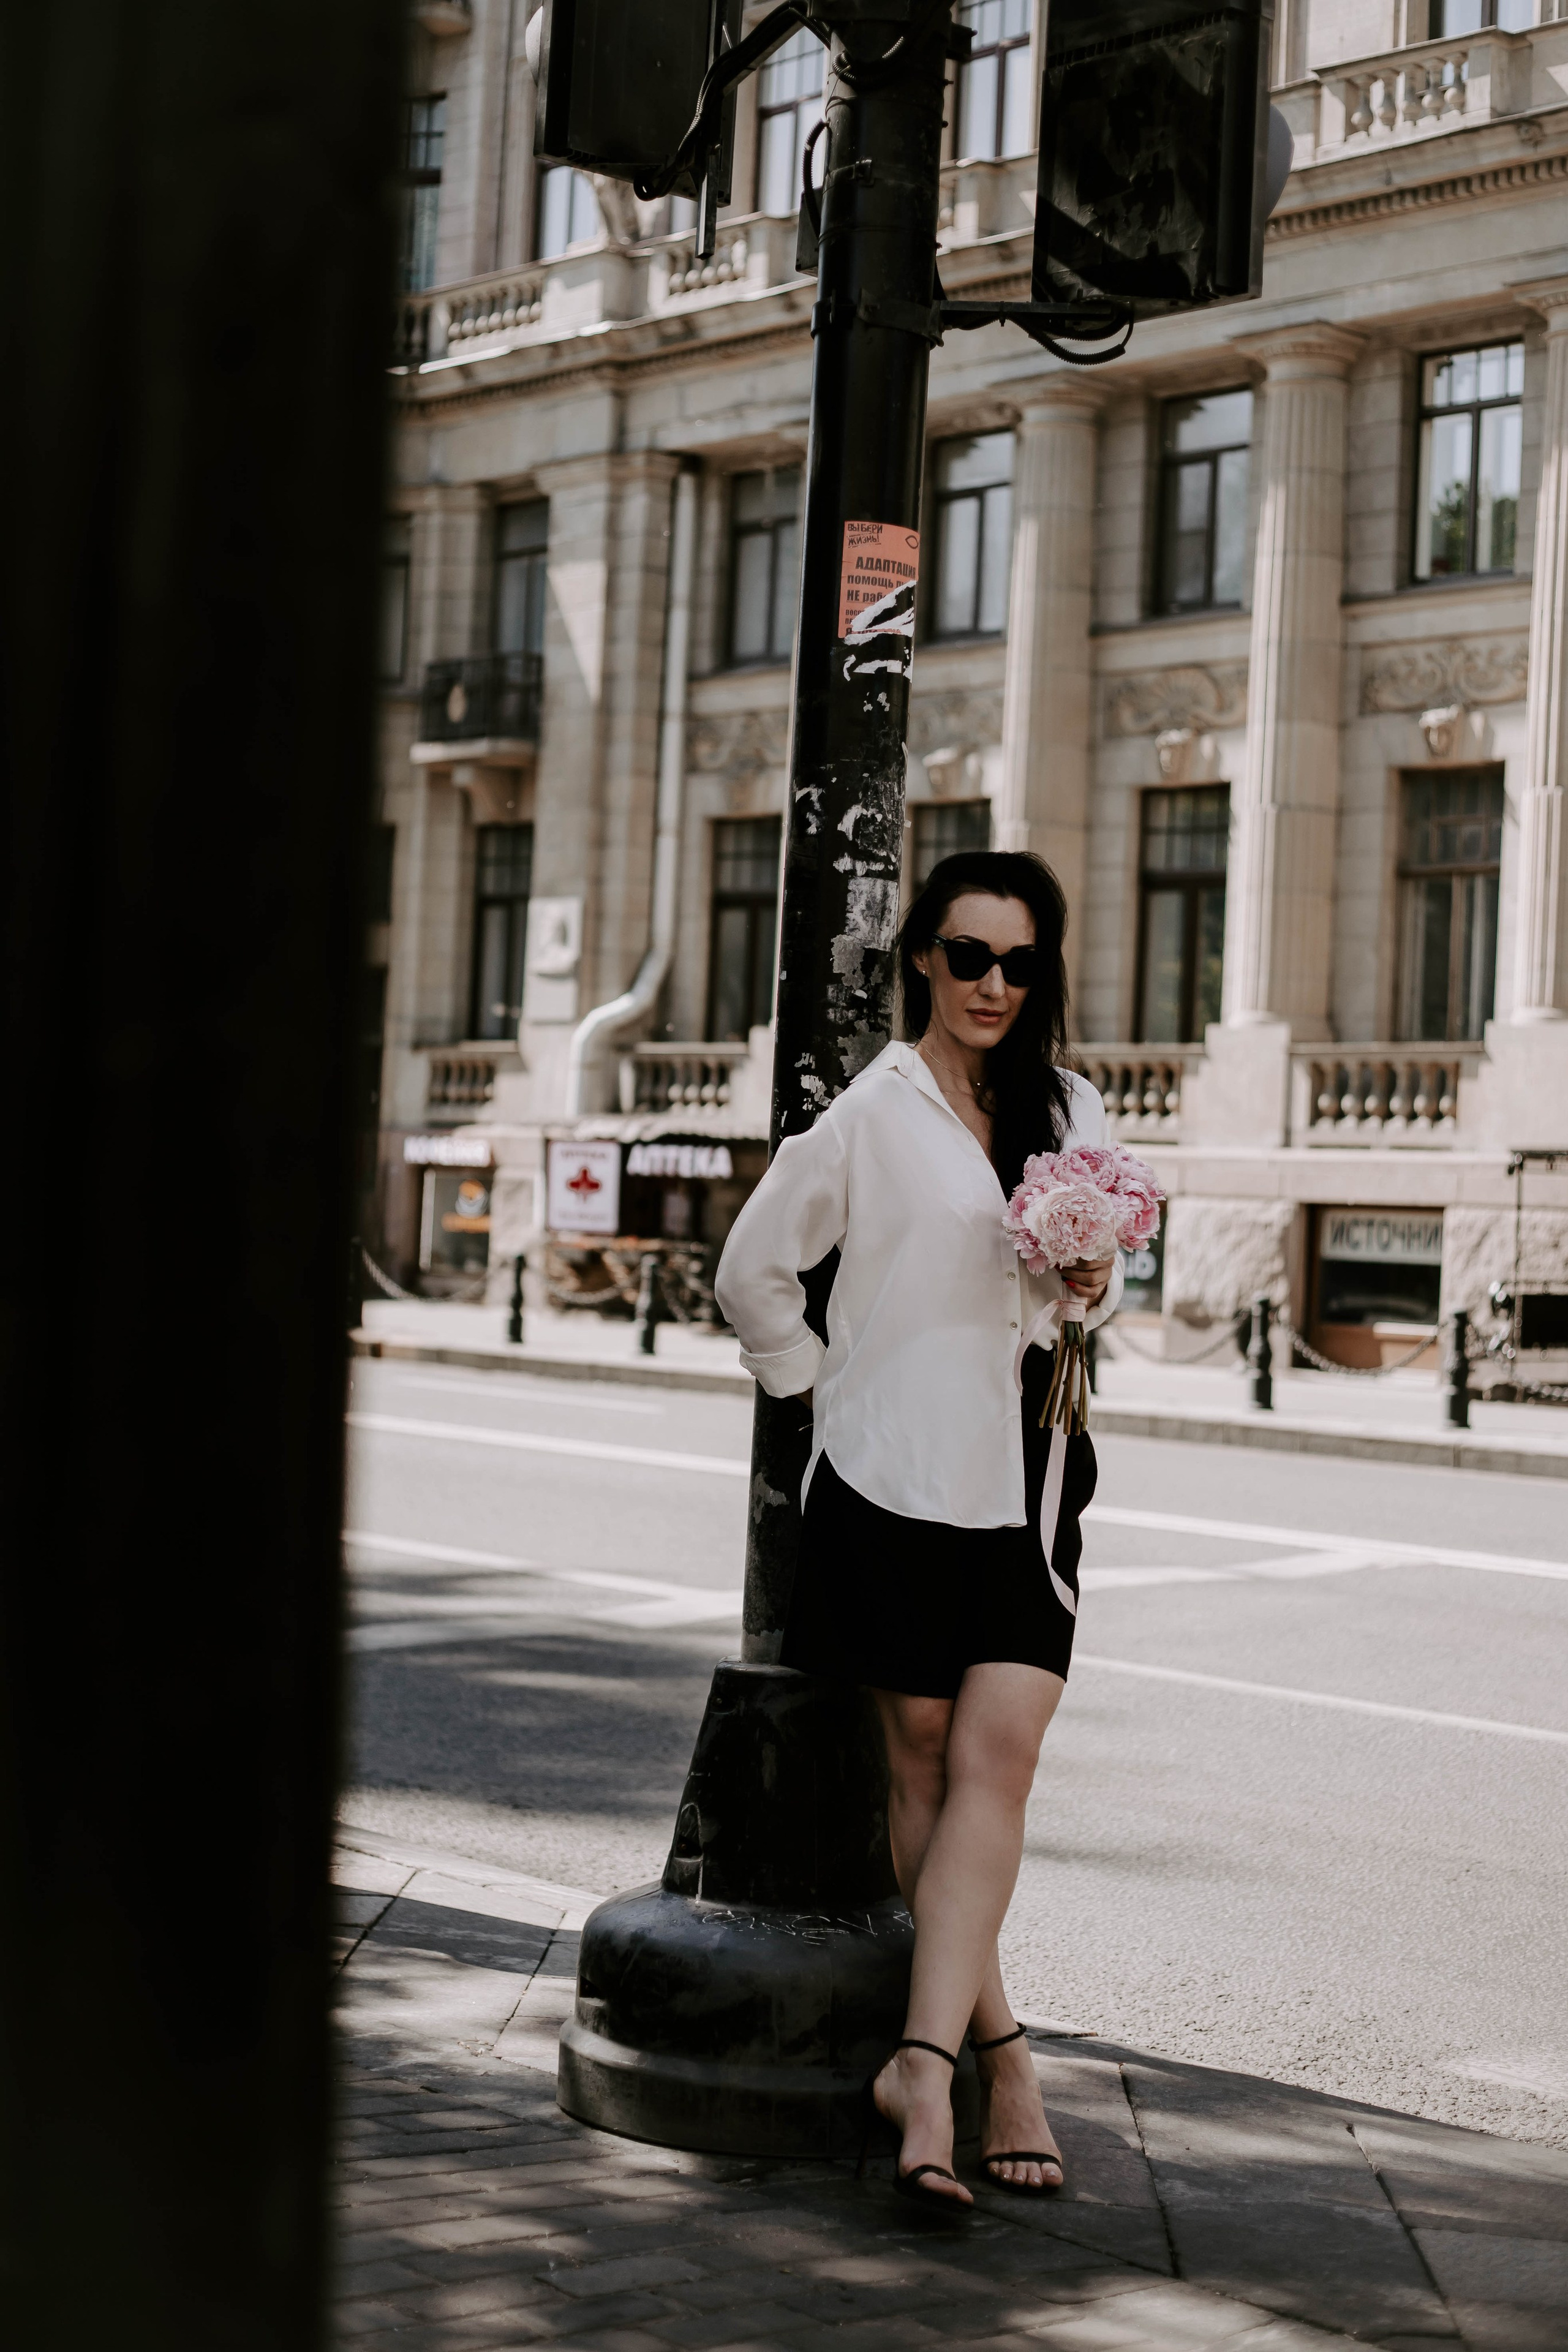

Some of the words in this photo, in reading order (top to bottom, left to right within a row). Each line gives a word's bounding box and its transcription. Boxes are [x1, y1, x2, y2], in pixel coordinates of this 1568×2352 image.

[855, 556, 916, 578] АДАПТАЦИЯ
[846, 589, 860, 601] НЕ
[862, 592, 886, 603] раб
[1330, 1219, 1443, 1252] ИСТОЧНИ
